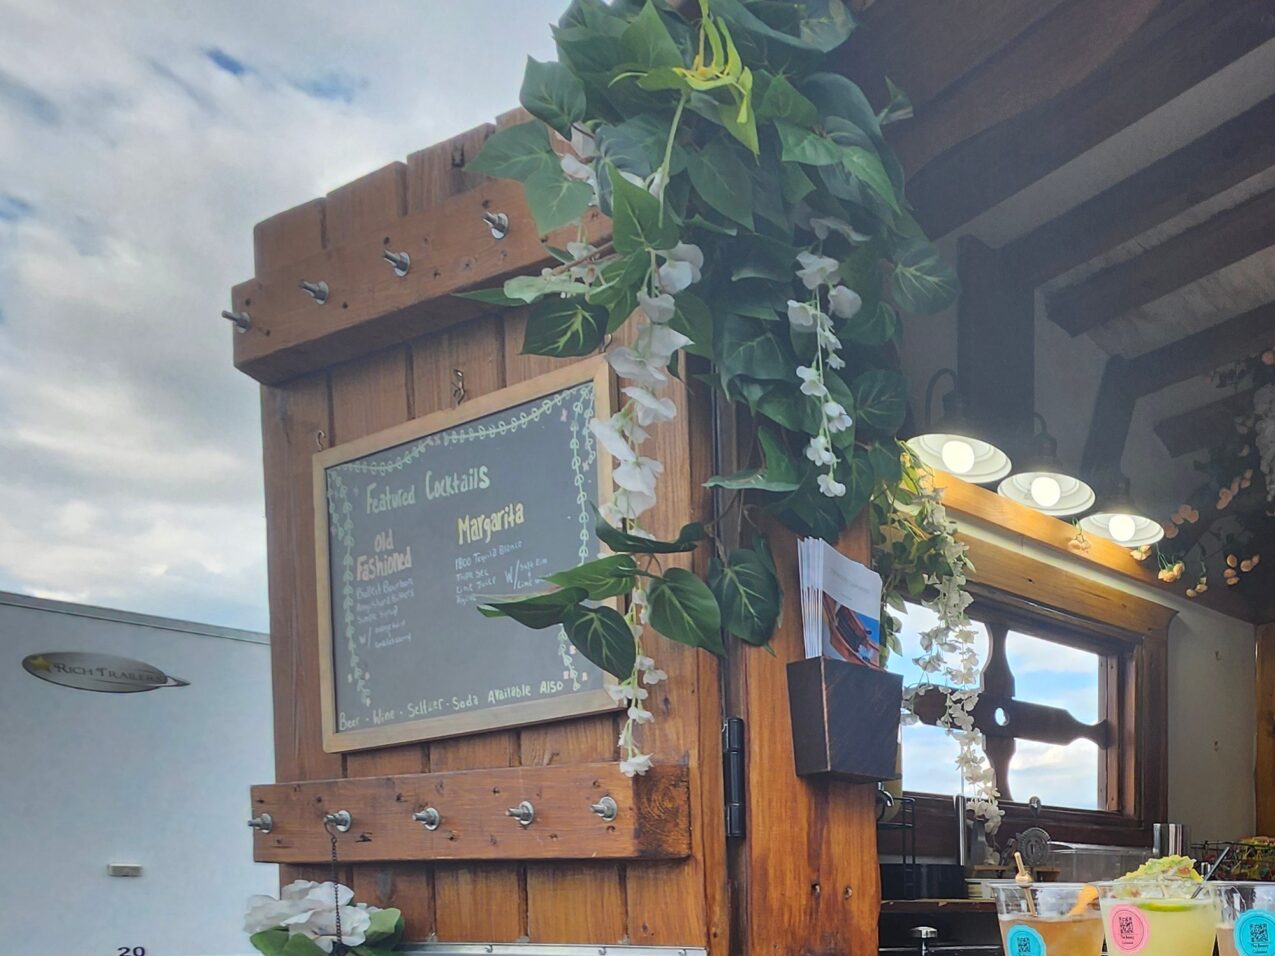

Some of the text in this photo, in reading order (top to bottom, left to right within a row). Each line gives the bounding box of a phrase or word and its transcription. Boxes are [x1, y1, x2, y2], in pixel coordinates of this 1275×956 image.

[366, 465, 490, 514] Featured Cocktails
[374, 528, 394, 552] Old
[458, 503, 525, 545] Margarita
[356, 546, 412, 581] Fashioned
[339, 712, 360, 731] Beer
[373, 708, 395, 725] Wine
[452, 694, 479, 711] Soda
